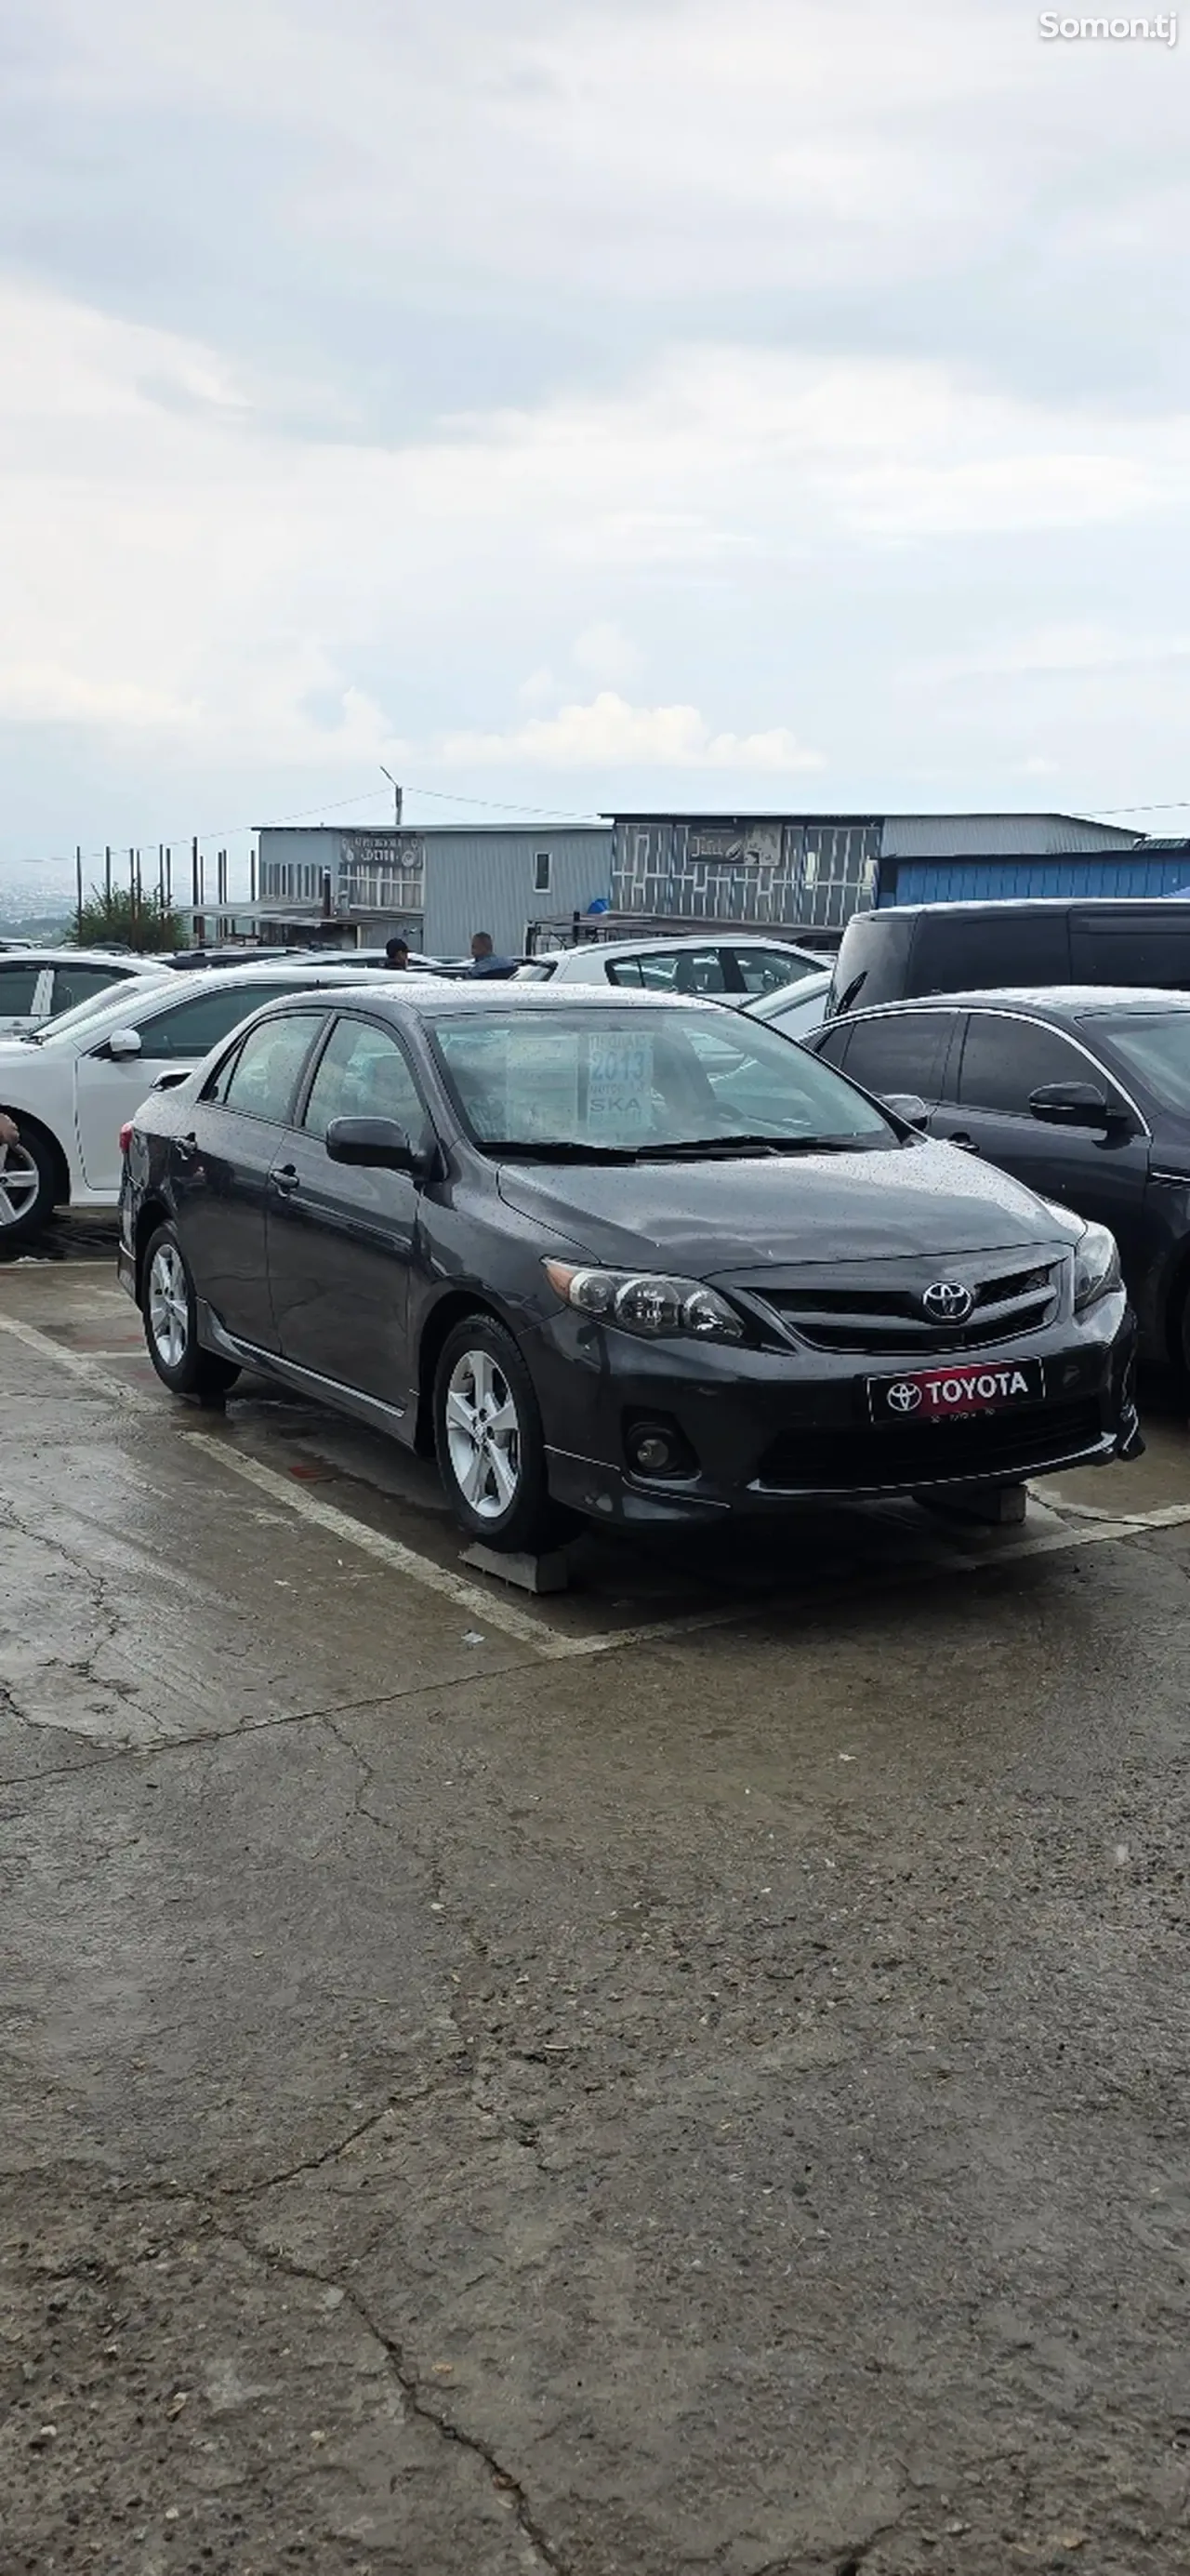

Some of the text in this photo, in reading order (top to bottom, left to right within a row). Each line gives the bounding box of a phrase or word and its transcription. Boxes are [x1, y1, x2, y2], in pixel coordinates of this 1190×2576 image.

[591, 1051, 644, 1081] 2013
[590, 1097, 641, 1113] SKA
[925, 1371, 1029, 1404] TOYOTA
